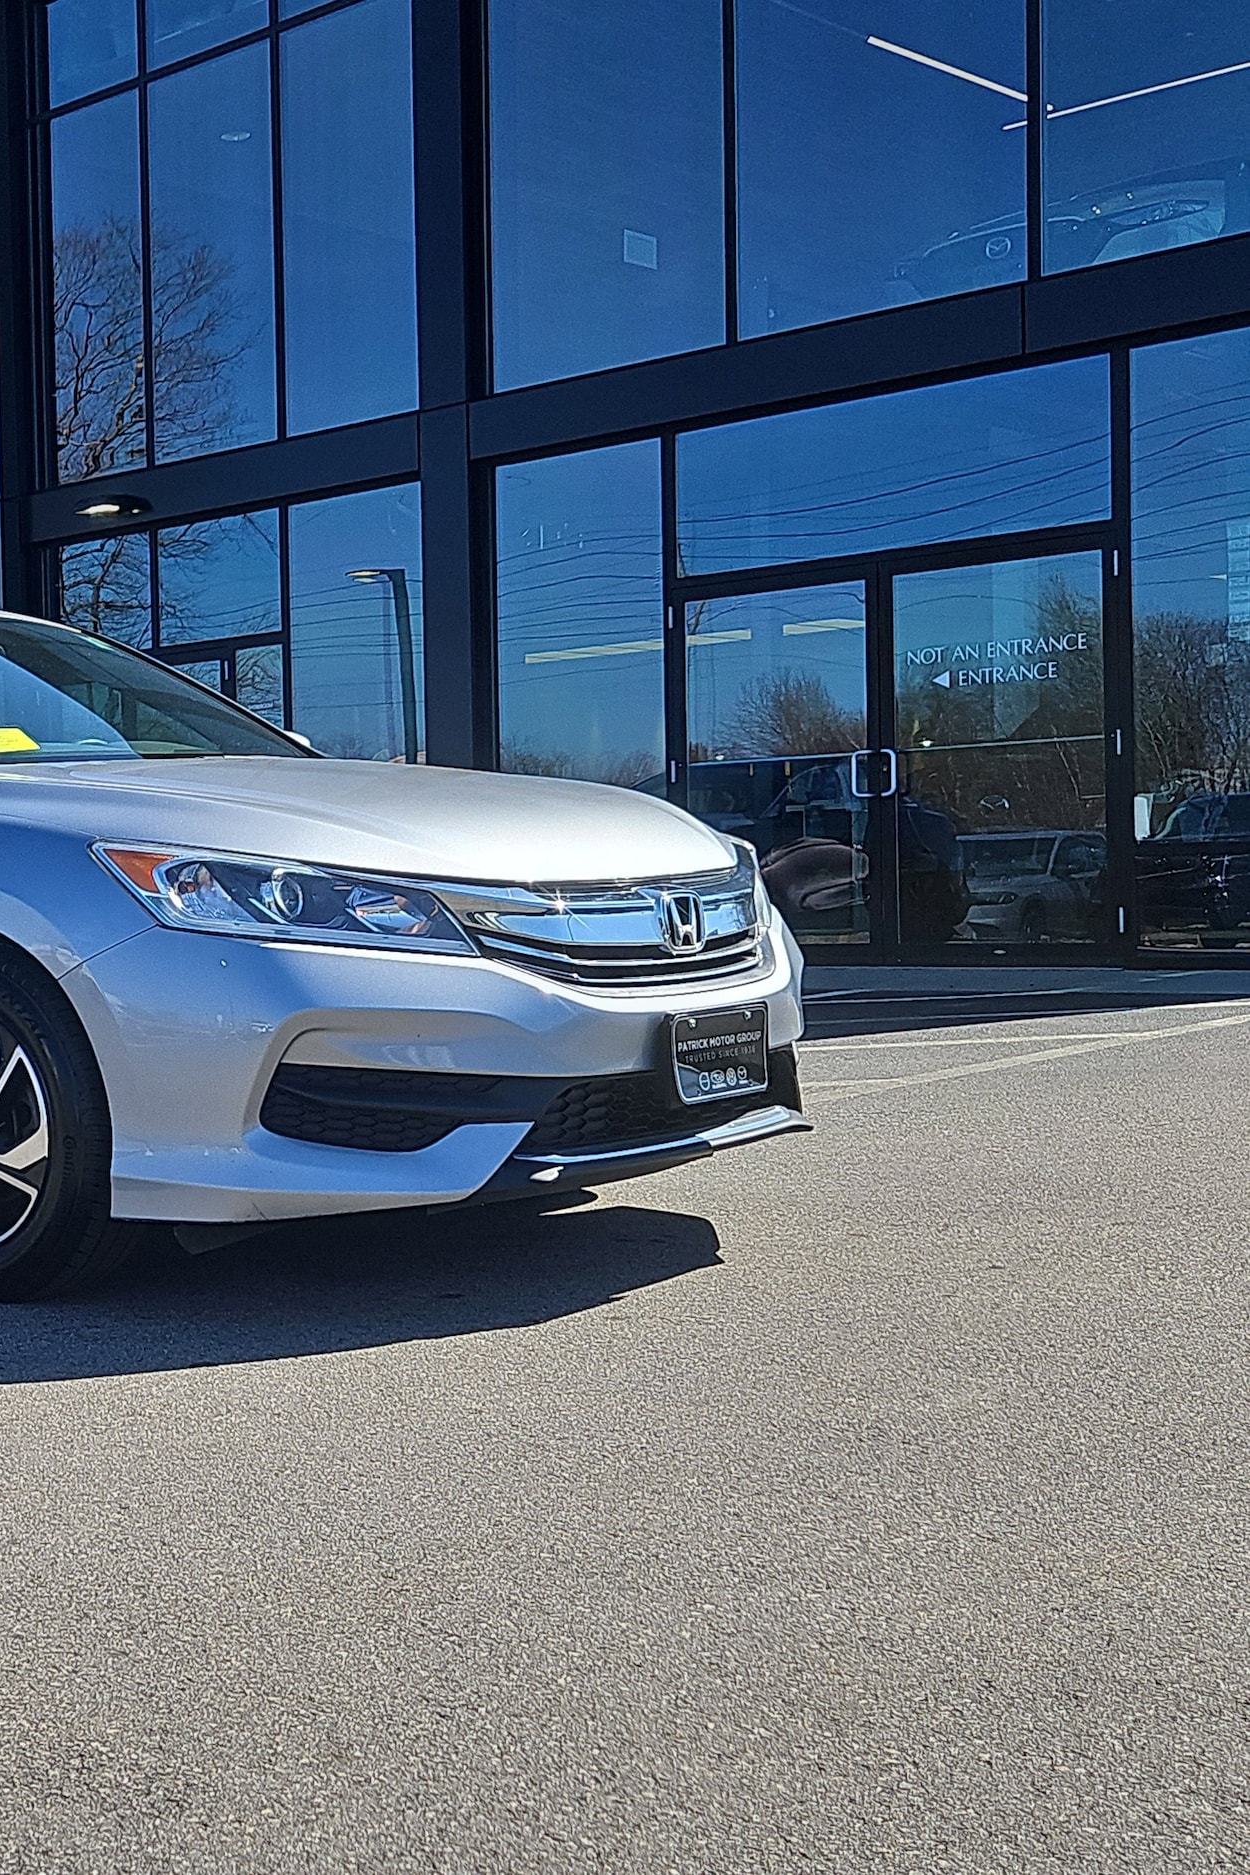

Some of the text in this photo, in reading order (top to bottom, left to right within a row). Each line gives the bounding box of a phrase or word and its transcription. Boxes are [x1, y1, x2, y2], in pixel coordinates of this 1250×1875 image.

[906, 632, 1088, 666] NOT AN ENTRANCE
[958, 661, 1058, 687] ENTRANCE
[677, 1030, 762, 1053] PATRICK MOTOR GROUP
